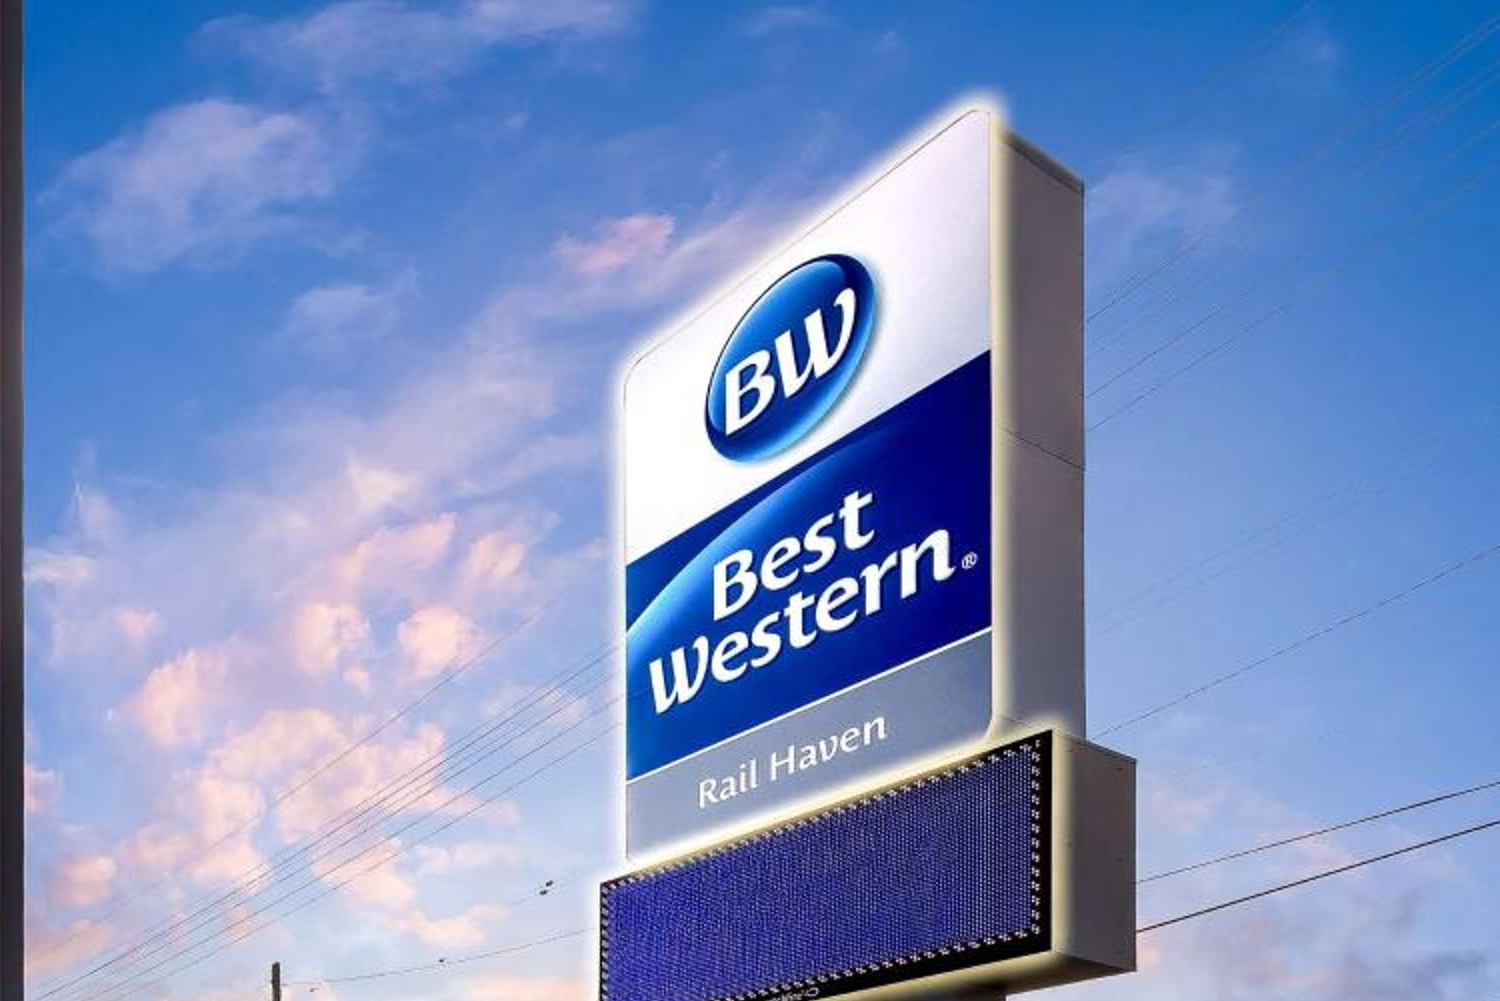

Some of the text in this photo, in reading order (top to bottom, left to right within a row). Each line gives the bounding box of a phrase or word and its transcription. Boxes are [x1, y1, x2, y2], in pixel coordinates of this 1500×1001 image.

[725, 287, 855, 435] BW
[650, 529, 955, 714] Western
[713, 491, 875, 621] Best
[699, 716, 886, 808] Rail Haven
